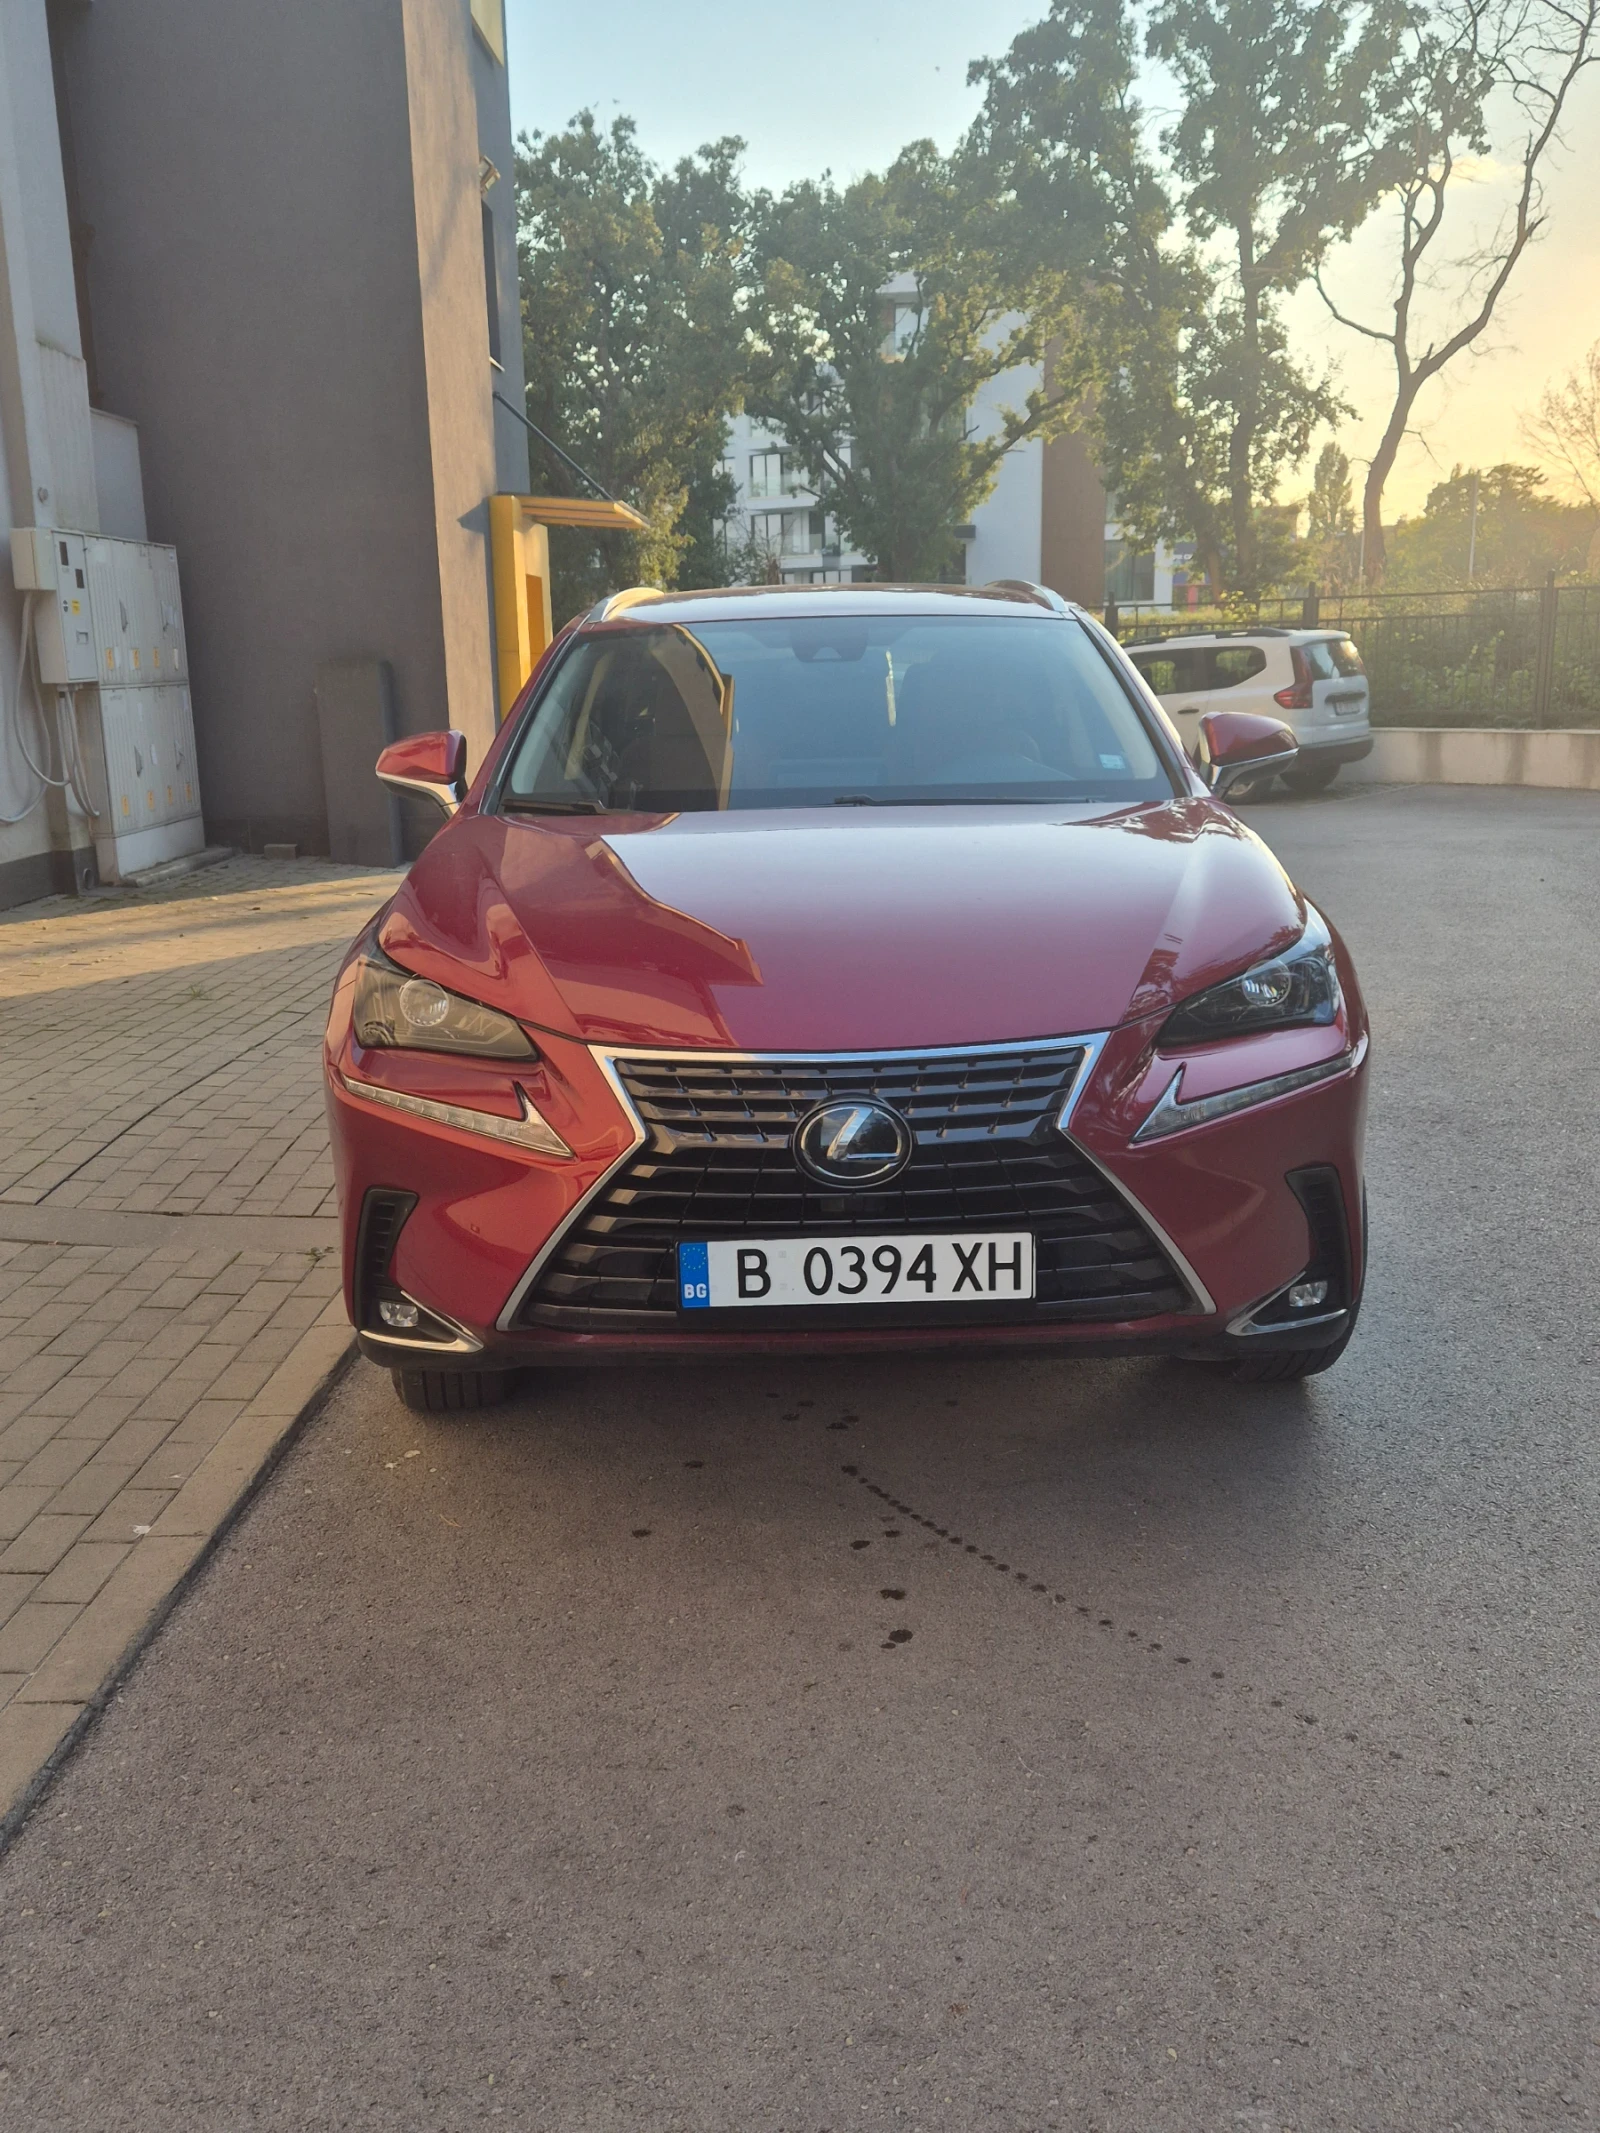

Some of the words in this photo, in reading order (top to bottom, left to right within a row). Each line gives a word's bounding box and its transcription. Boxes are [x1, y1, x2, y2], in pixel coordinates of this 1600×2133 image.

[736, 1249, 772, 1299] B
[803, 1243, 937, 1296] 0394
[951, 1241, 1022, 1293] XH
[684, 1283, 707, 1299] BG
